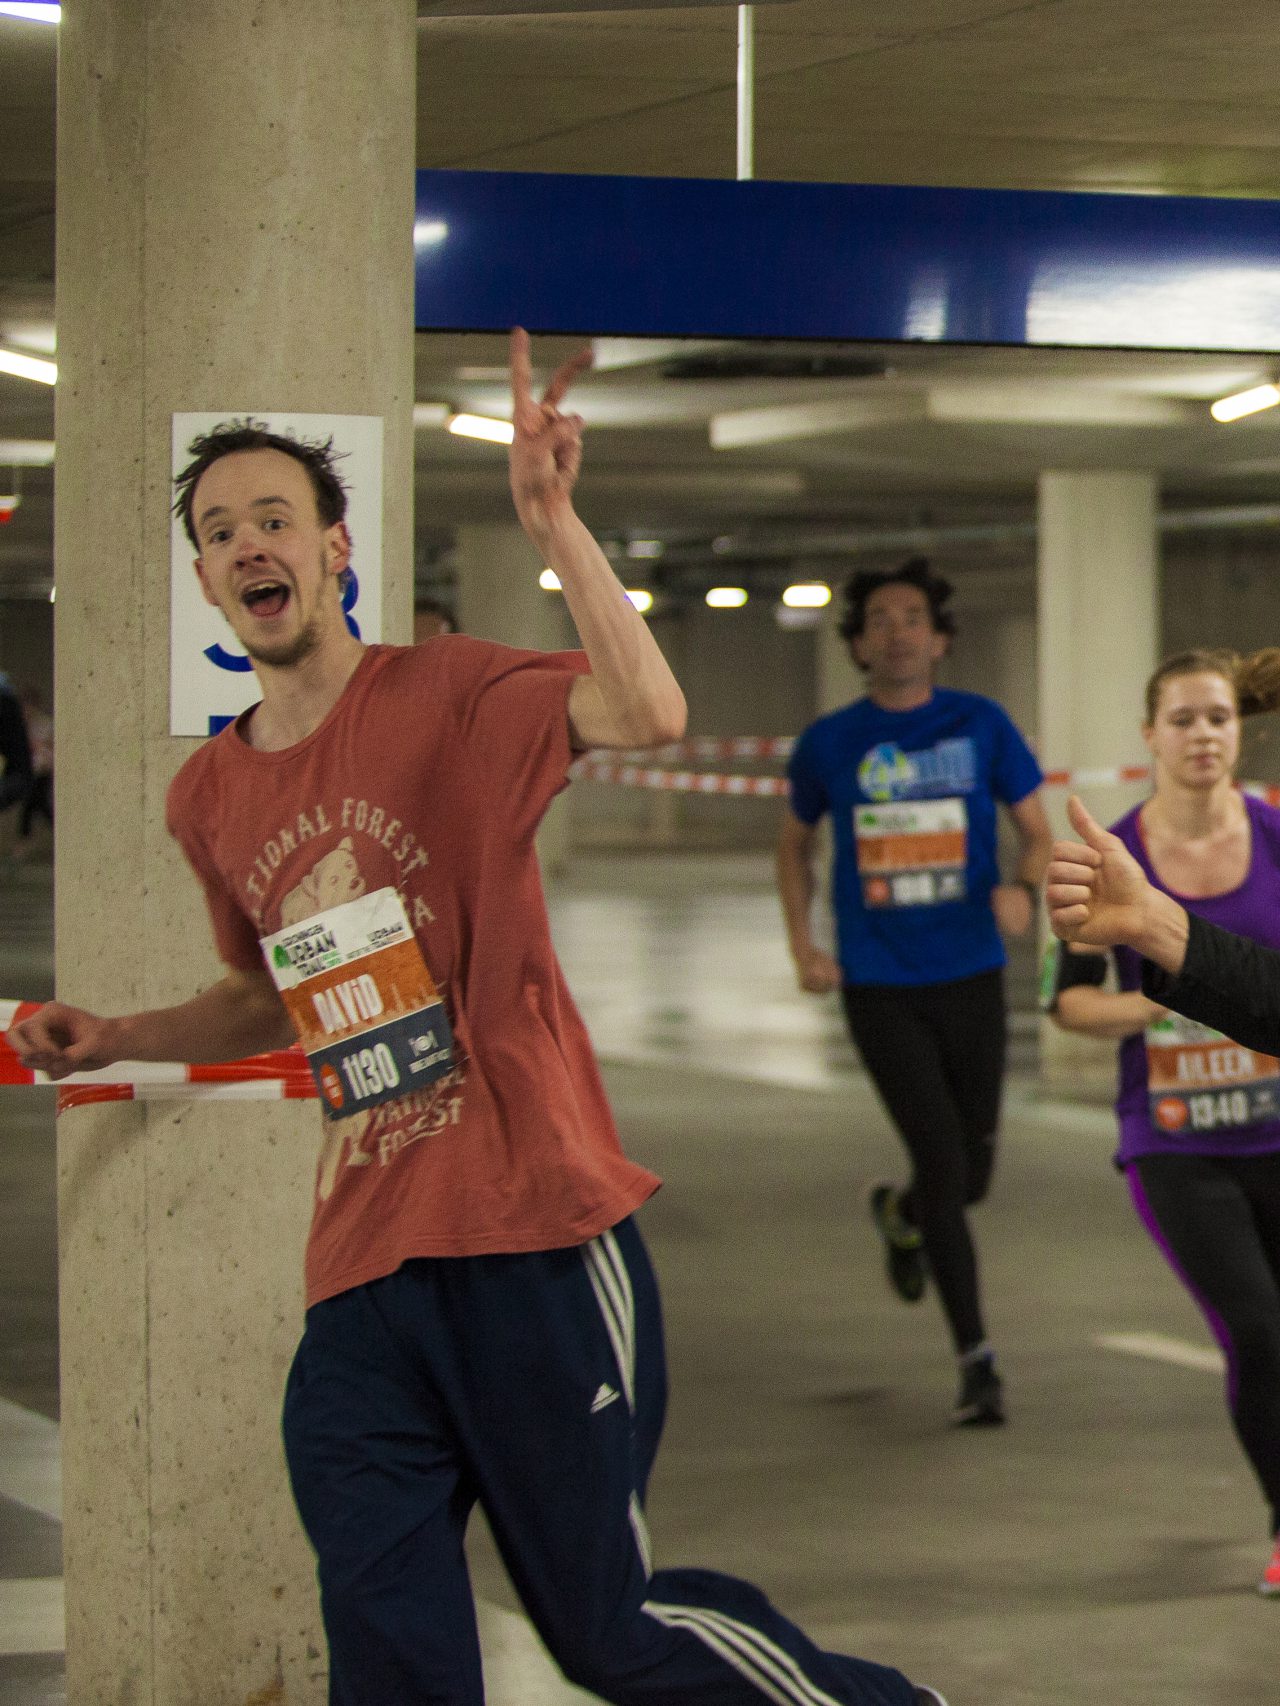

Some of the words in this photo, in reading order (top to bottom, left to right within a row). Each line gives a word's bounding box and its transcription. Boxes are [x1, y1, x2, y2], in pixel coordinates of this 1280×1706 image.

[246, 804, 333, 900] TIONAL
[340, 797, 430, 877] FOREST
[341, 1042, 401, 1101] 1130
